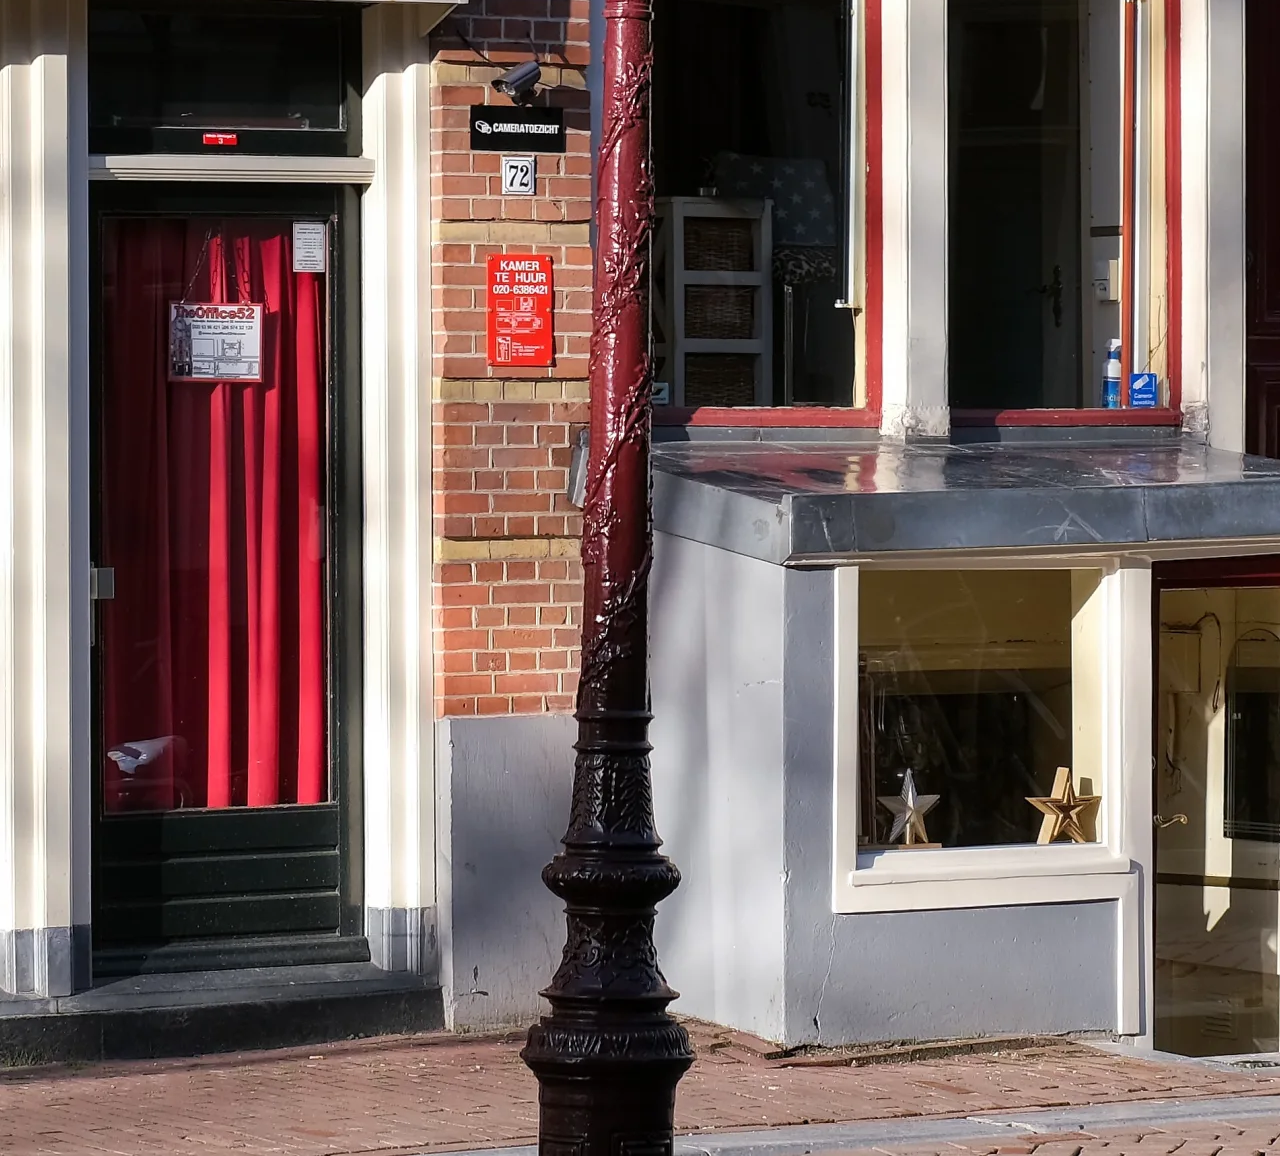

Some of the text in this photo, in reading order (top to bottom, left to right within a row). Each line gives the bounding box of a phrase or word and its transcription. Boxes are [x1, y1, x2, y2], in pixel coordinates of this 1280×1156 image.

[493, 123, 559, 134] CAMERATOEZICHT
[508, 165, 529, 188] 72
[500, 260, 540, 271] KAMER
[494, 272, 546, 283] TE HUUR
[493, 285, 548, 294] 020-6386421
